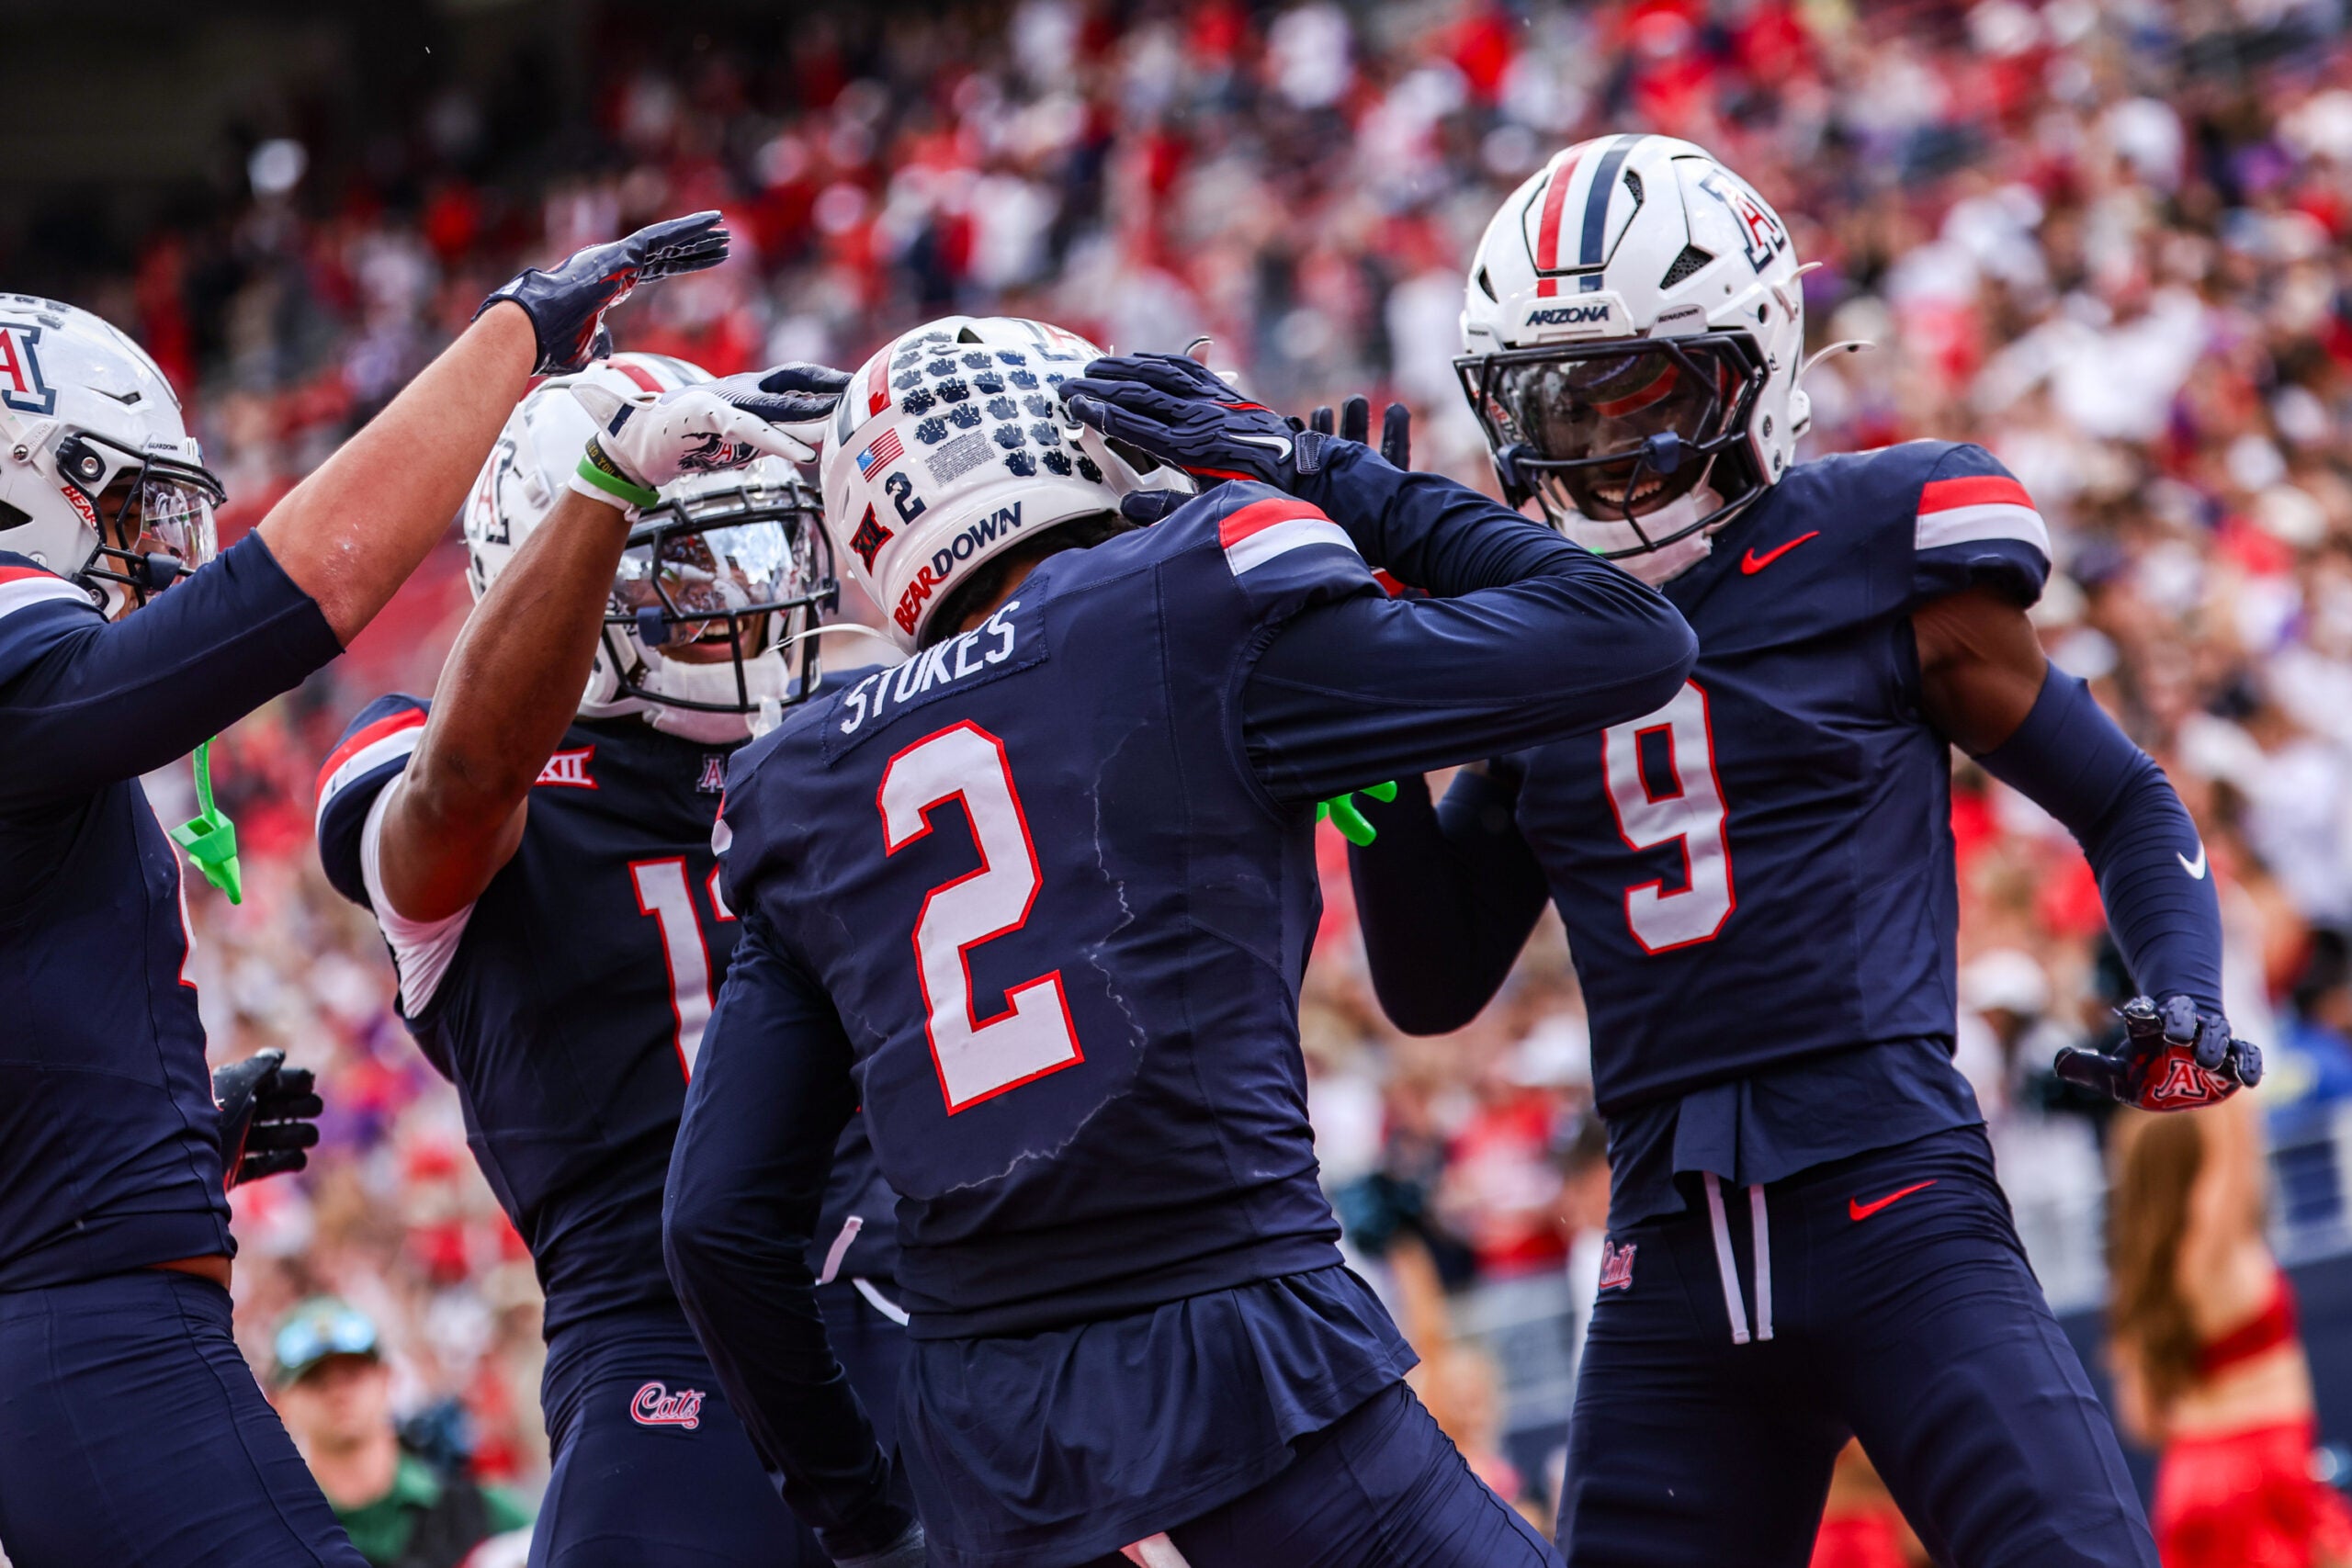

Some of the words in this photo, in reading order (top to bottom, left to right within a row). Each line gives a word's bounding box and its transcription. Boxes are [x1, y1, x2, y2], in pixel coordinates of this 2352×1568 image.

[1699, 169, 1786, 274] A
[1525, 305, 1610, 326] ARIZONA
[937, 434, 967, 451] WARNING
[885, 471, 927, 525] 2
[840, 600, 1021, 735] STOKES
[697, 756, 725, 791] A
[1601, 677, 1736, 955] 9
[876, 718, 1085, 1117] 2
[628, 855, 739, 1085] 1
[2153, 1058, 2209, 1100] A
[1600, 1240, 1637, 1290] Cats
[630, 1382, 706, 1429] Cats
